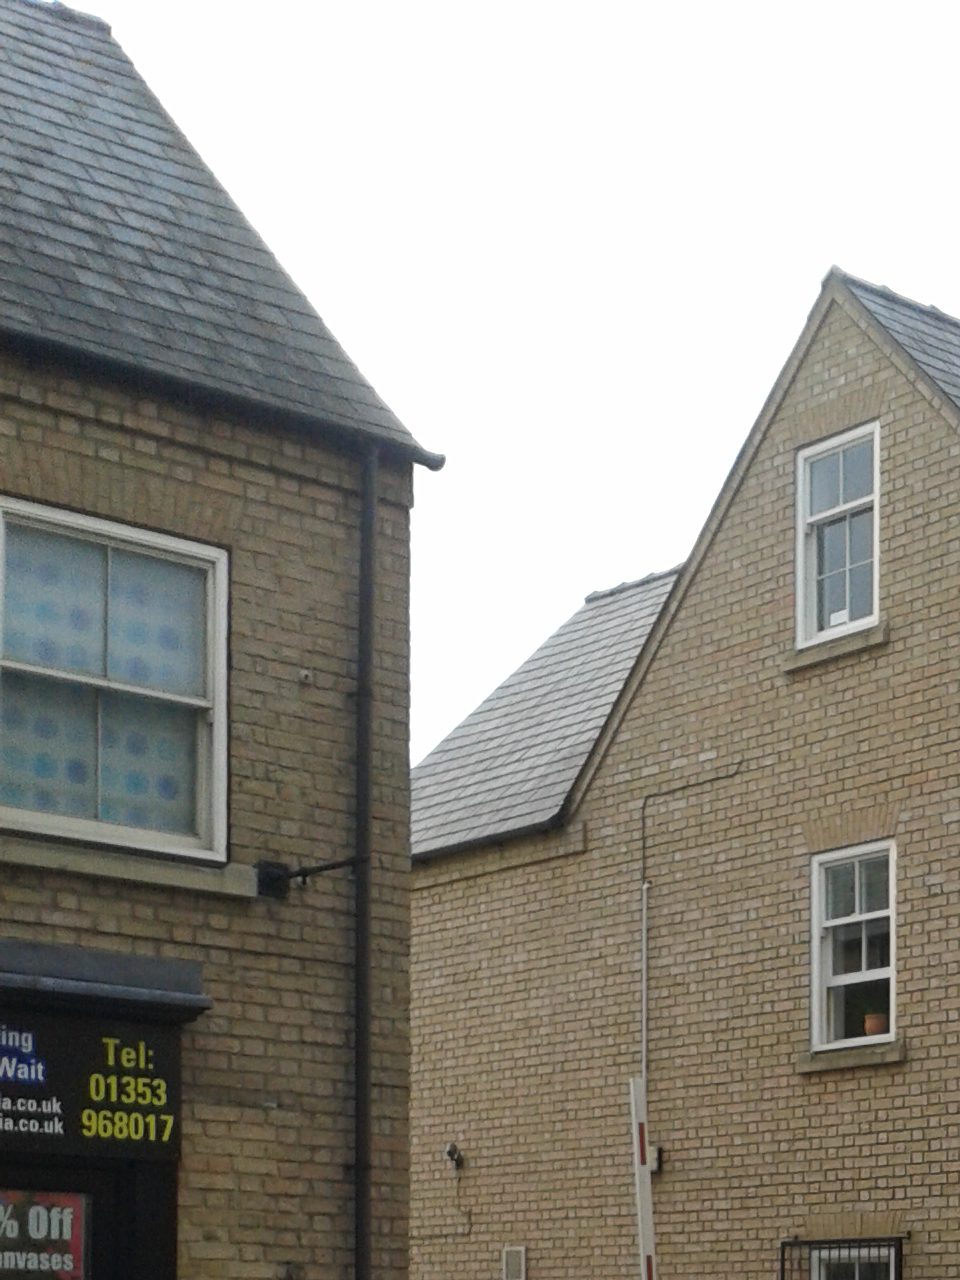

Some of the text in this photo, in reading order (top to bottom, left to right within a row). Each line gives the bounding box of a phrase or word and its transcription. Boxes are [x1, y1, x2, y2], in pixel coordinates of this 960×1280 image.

[102, 1037, 155, 1070] Tel:
[0, 1096, 62, 1115] a.co.uk
[89, 1073, 167, 1106] 01353
[81, 1108, 175, 1142] 968017
[27, 1205, 74, 1240] Off
[0, 1251, 74, 1271] nvases
